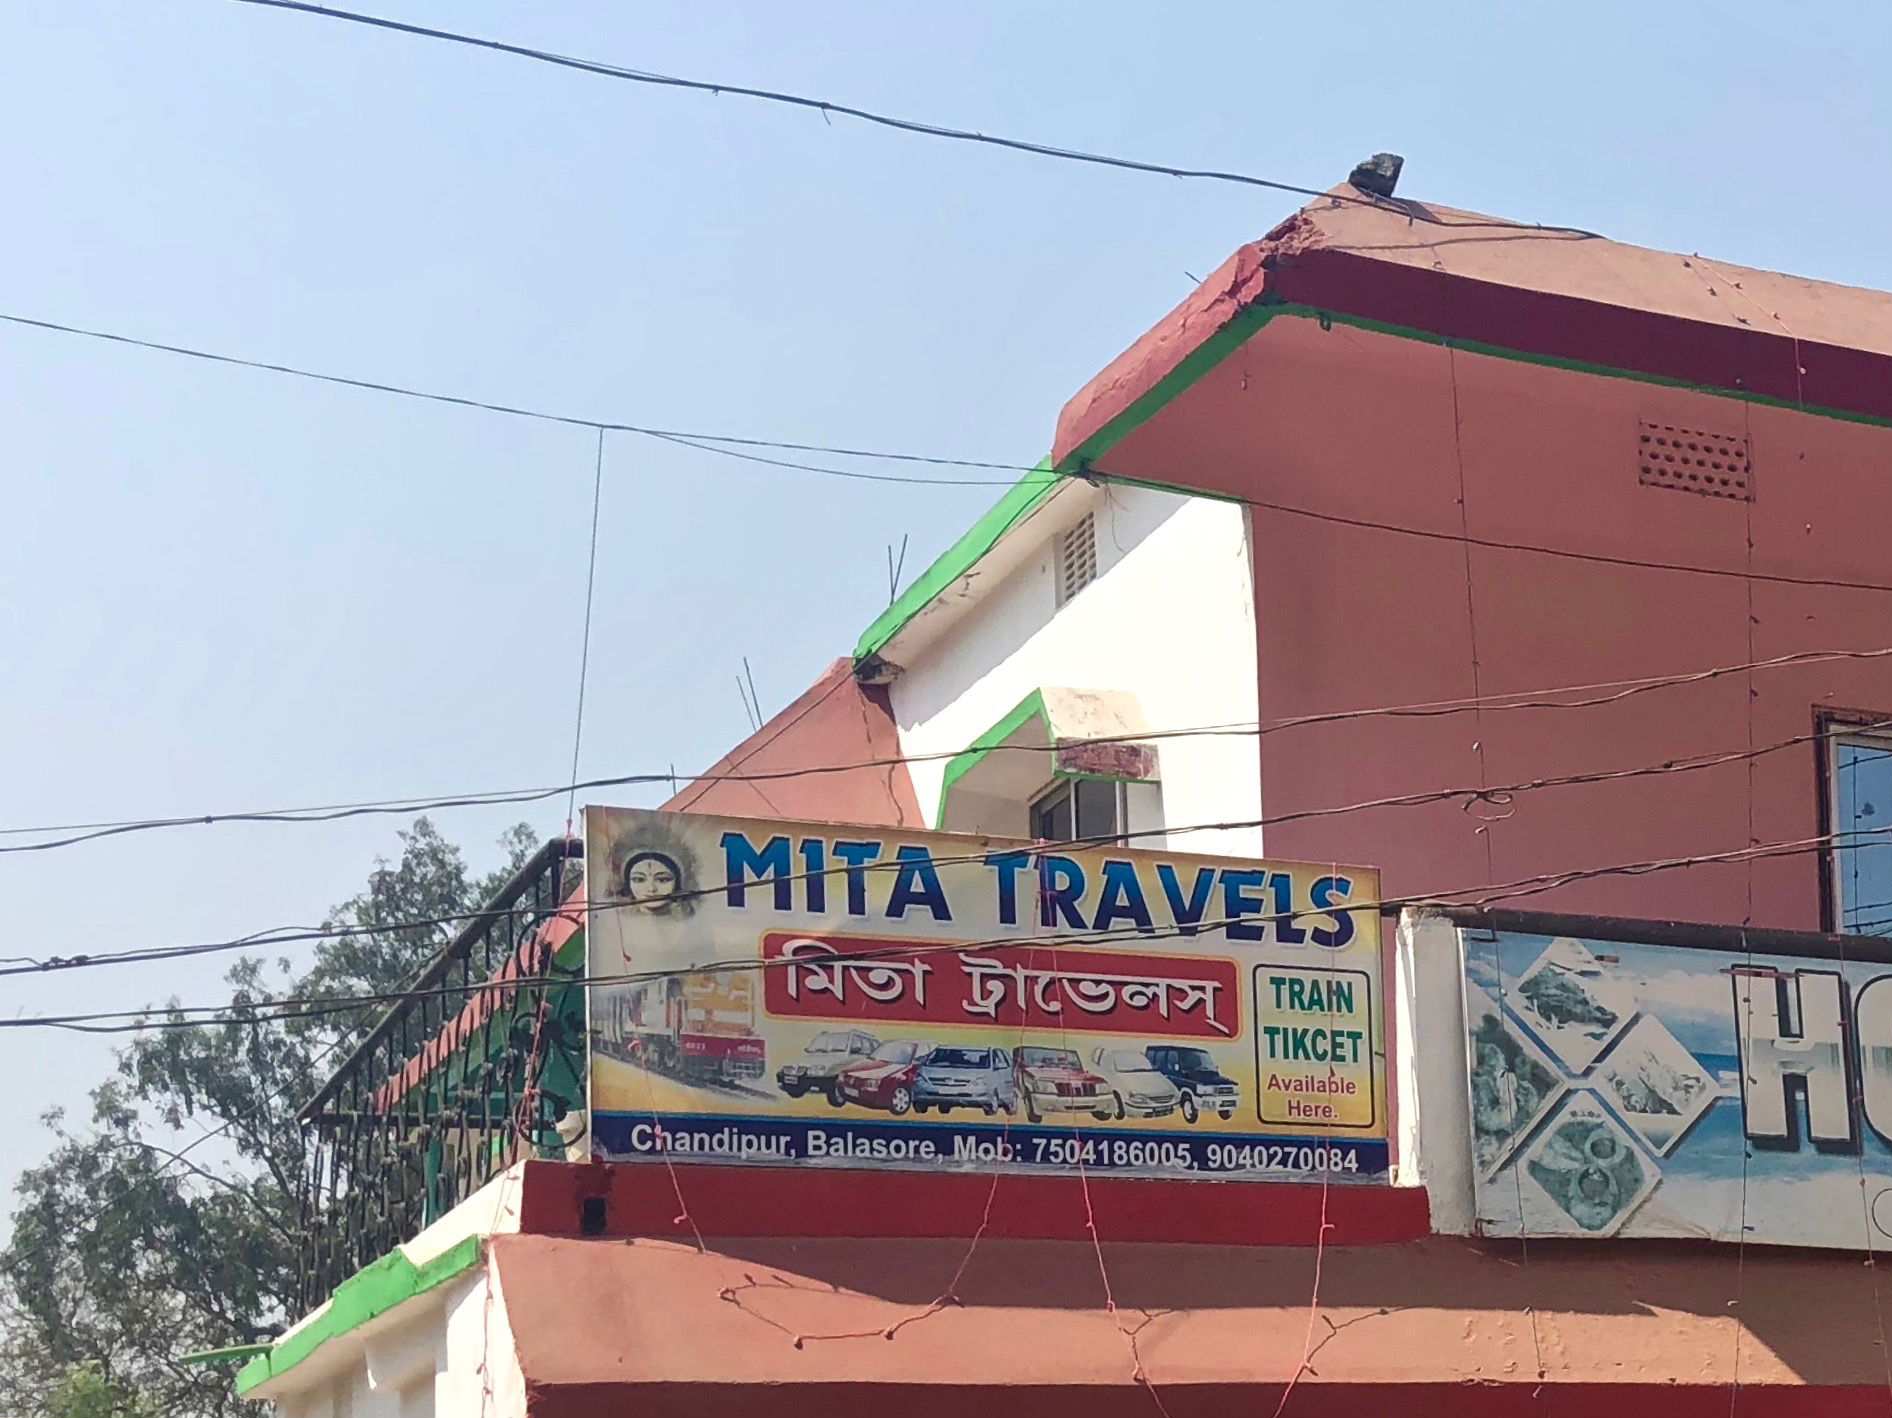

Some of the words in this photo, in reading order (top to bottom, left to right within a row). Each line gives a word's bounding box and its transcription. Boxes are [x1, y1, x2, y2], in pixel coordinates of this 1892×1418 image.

[720, 831, 953, 925] MITA
[982, 847, 1355, 948] TRAVELS
[780, 938, 933, 1000] মিতা
[1269, 976, 1354, 1016] TRAIN
[1262, 1024, 1364, 1065] TIKCET
[1266, 1072, 1357, 1098] Available
[1286, 1098, 1340, 1121] Here.
[630, 1123, 797, 1160] Chandipur,
[807, 1130, 944, 1164] Balasore,
[953, 1135, 1023, 1164] Mob:
[1031, 1138, 1199, 1171] 7504186005,
[1207, 1144, 1359, 1174] 9040270084
